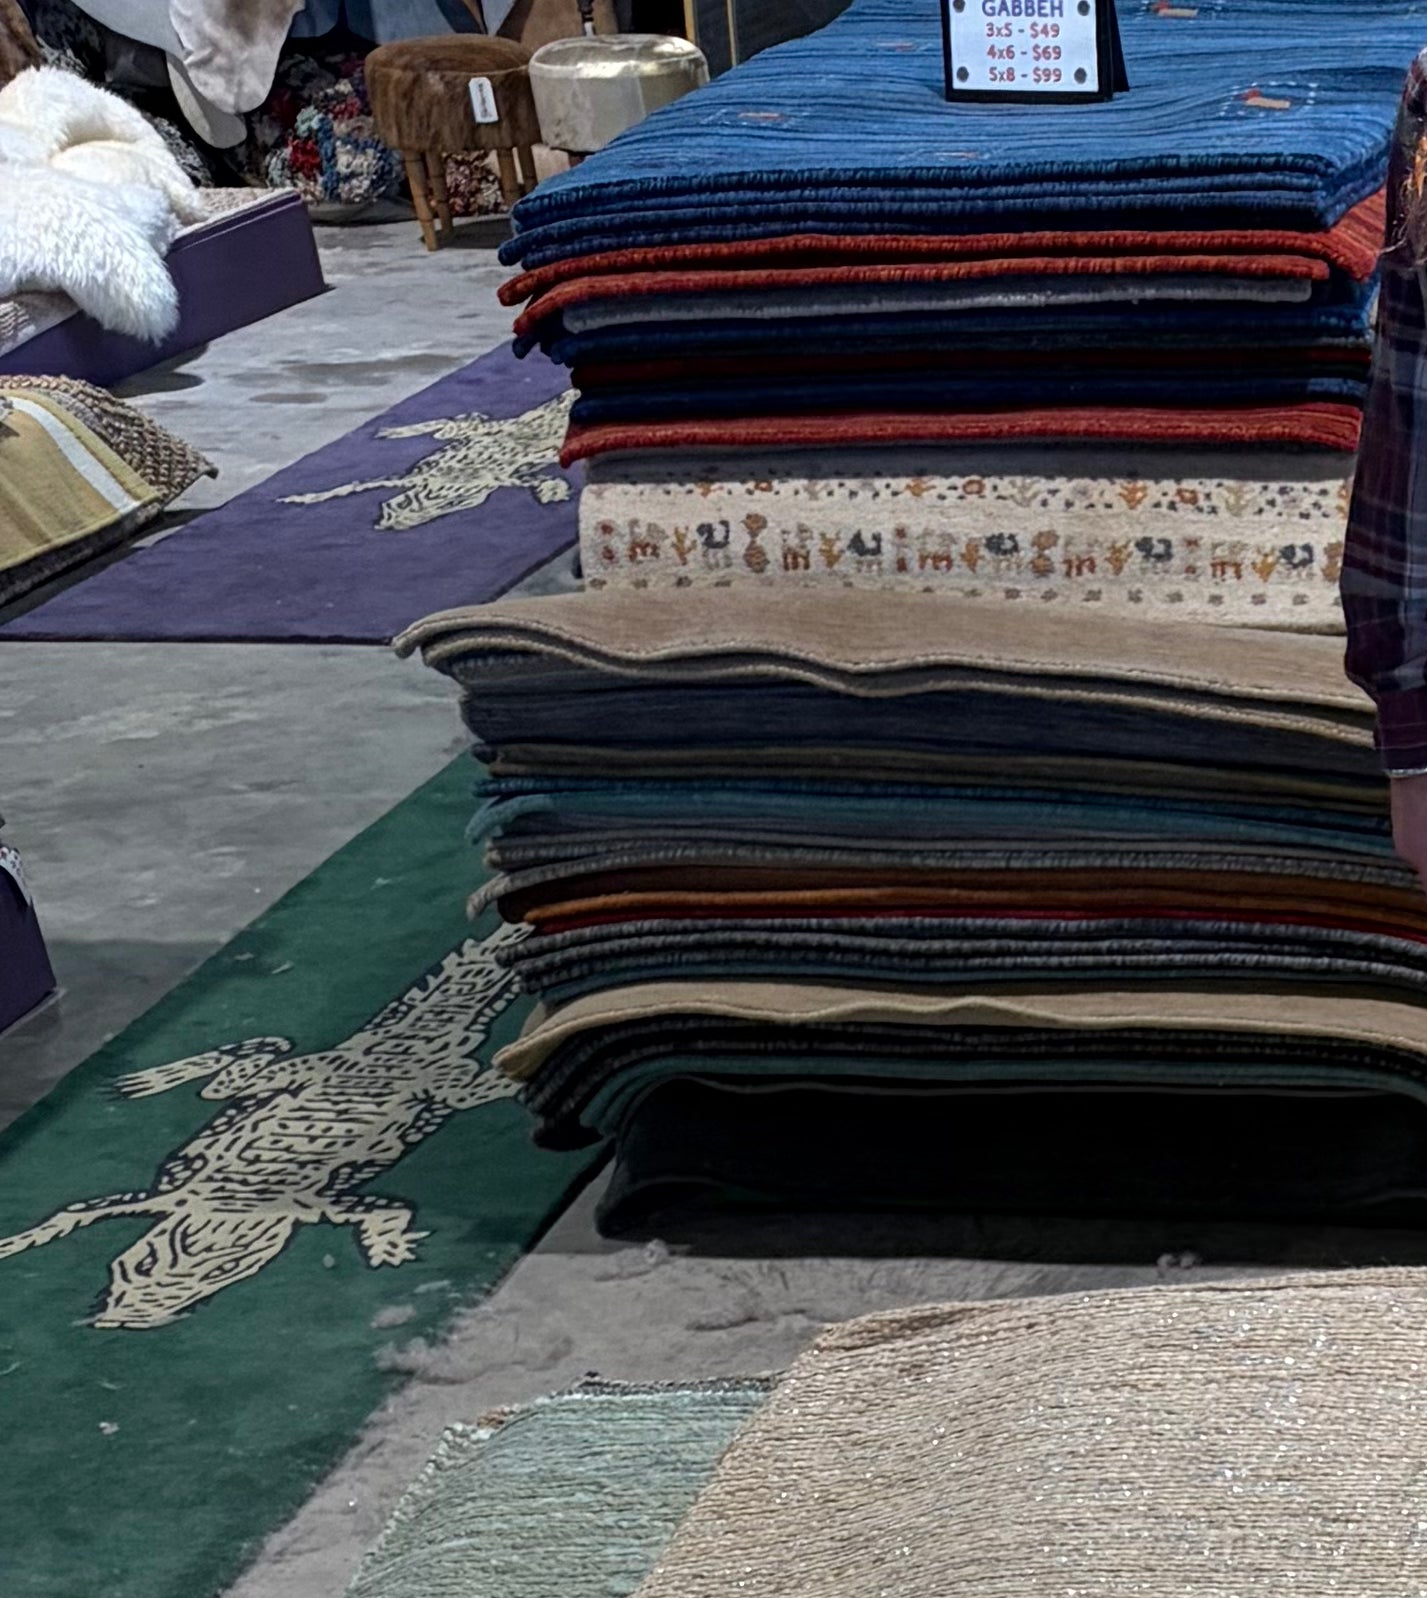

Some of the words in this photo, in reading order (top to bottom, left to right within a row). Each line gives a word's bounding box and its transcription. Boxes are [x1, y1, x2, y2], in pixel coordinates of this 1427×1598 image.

[982, 0, 1064, 17] GABBEH
[986, 22, 1013, 37] 3x5
[1030, 21, 1060, 39] $49
[987, 44, 1015, 60] 4x6
[1032, 44, 1062, 61] $69
[989, 66, 1016, 82] 5x8
[1033, 66, 1062, 83] $99
